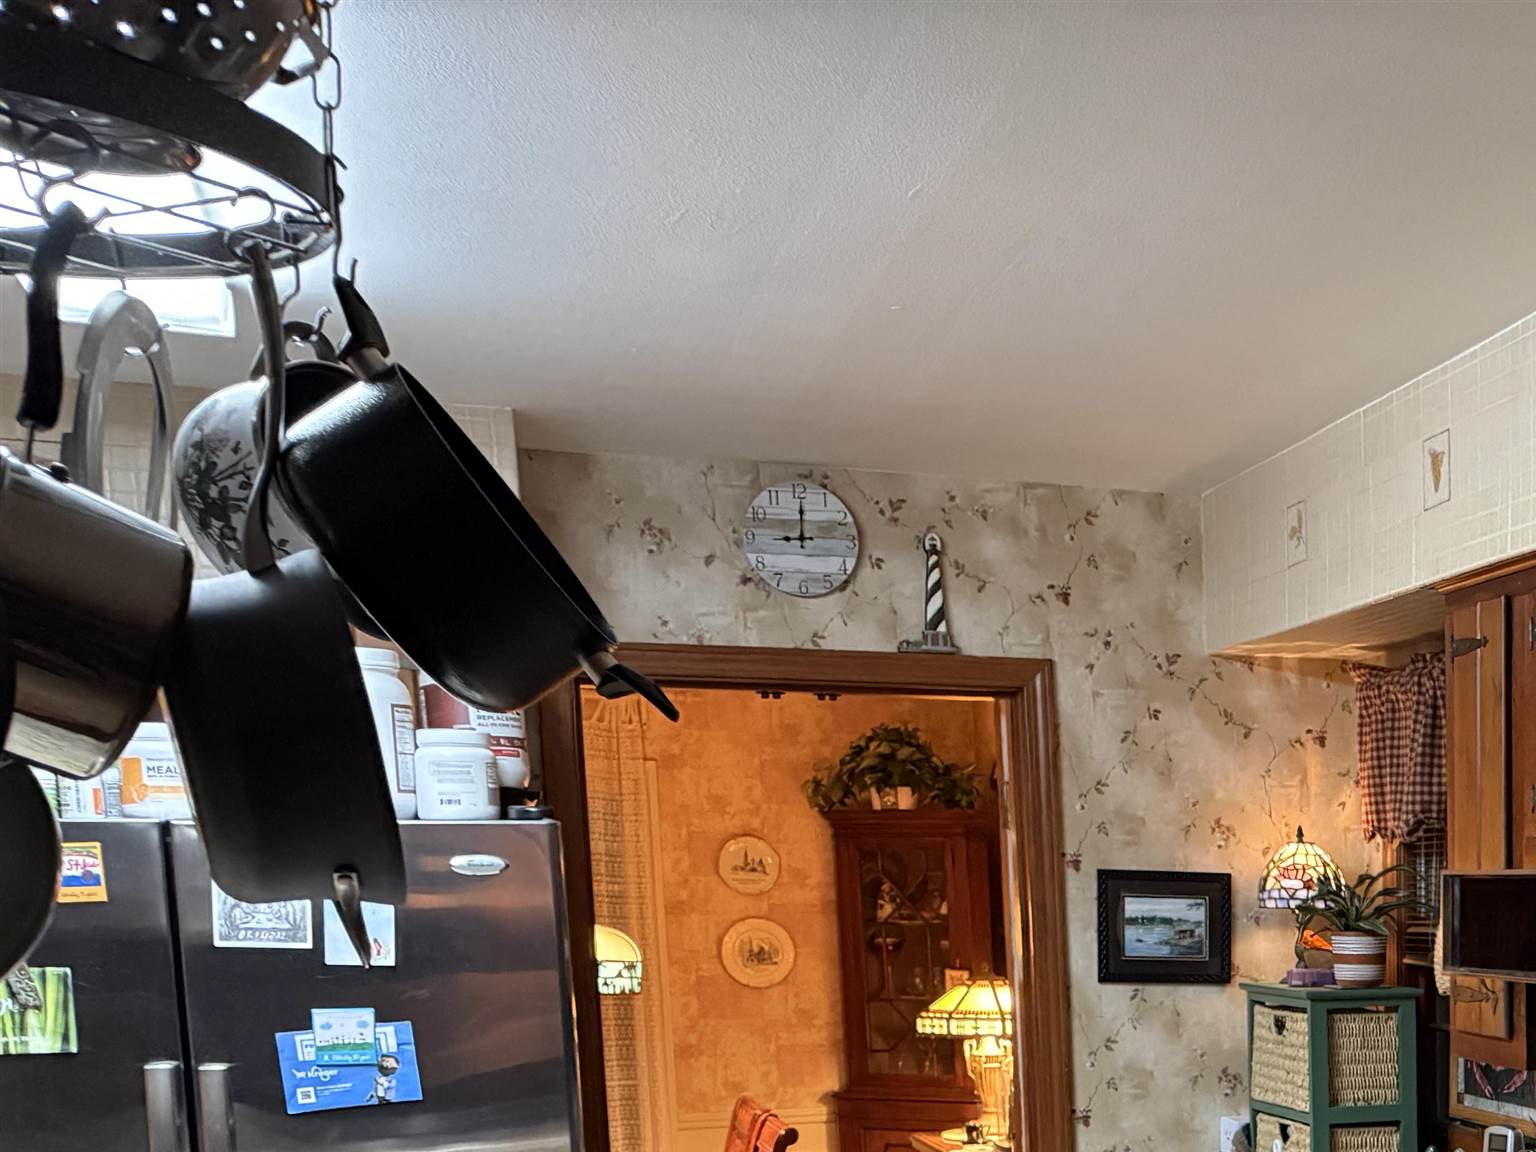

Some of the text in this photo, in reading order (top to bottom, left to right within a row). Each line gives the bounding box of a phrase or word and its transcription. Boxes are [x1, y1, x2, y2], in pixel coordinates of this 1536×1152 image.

[767, 489, 780, 506] 11
[792, 483, 807, 500] 12
[823, 492, 828, 508] 1
[751, 506, 767, 523] 10
[837, 510, 848, 527] 2
[744, 529, 756, 545] 9
[845, 534, 857, 550] 3
[755, 555, 766, 572] 8
[838, 559, 848, 575] 4
[773, 572, 783, 588] 7
[798, 579, 809, 595] 6
[823, 574, 834, 590] 5
[307, 1065, 338, 1082] Kroger
